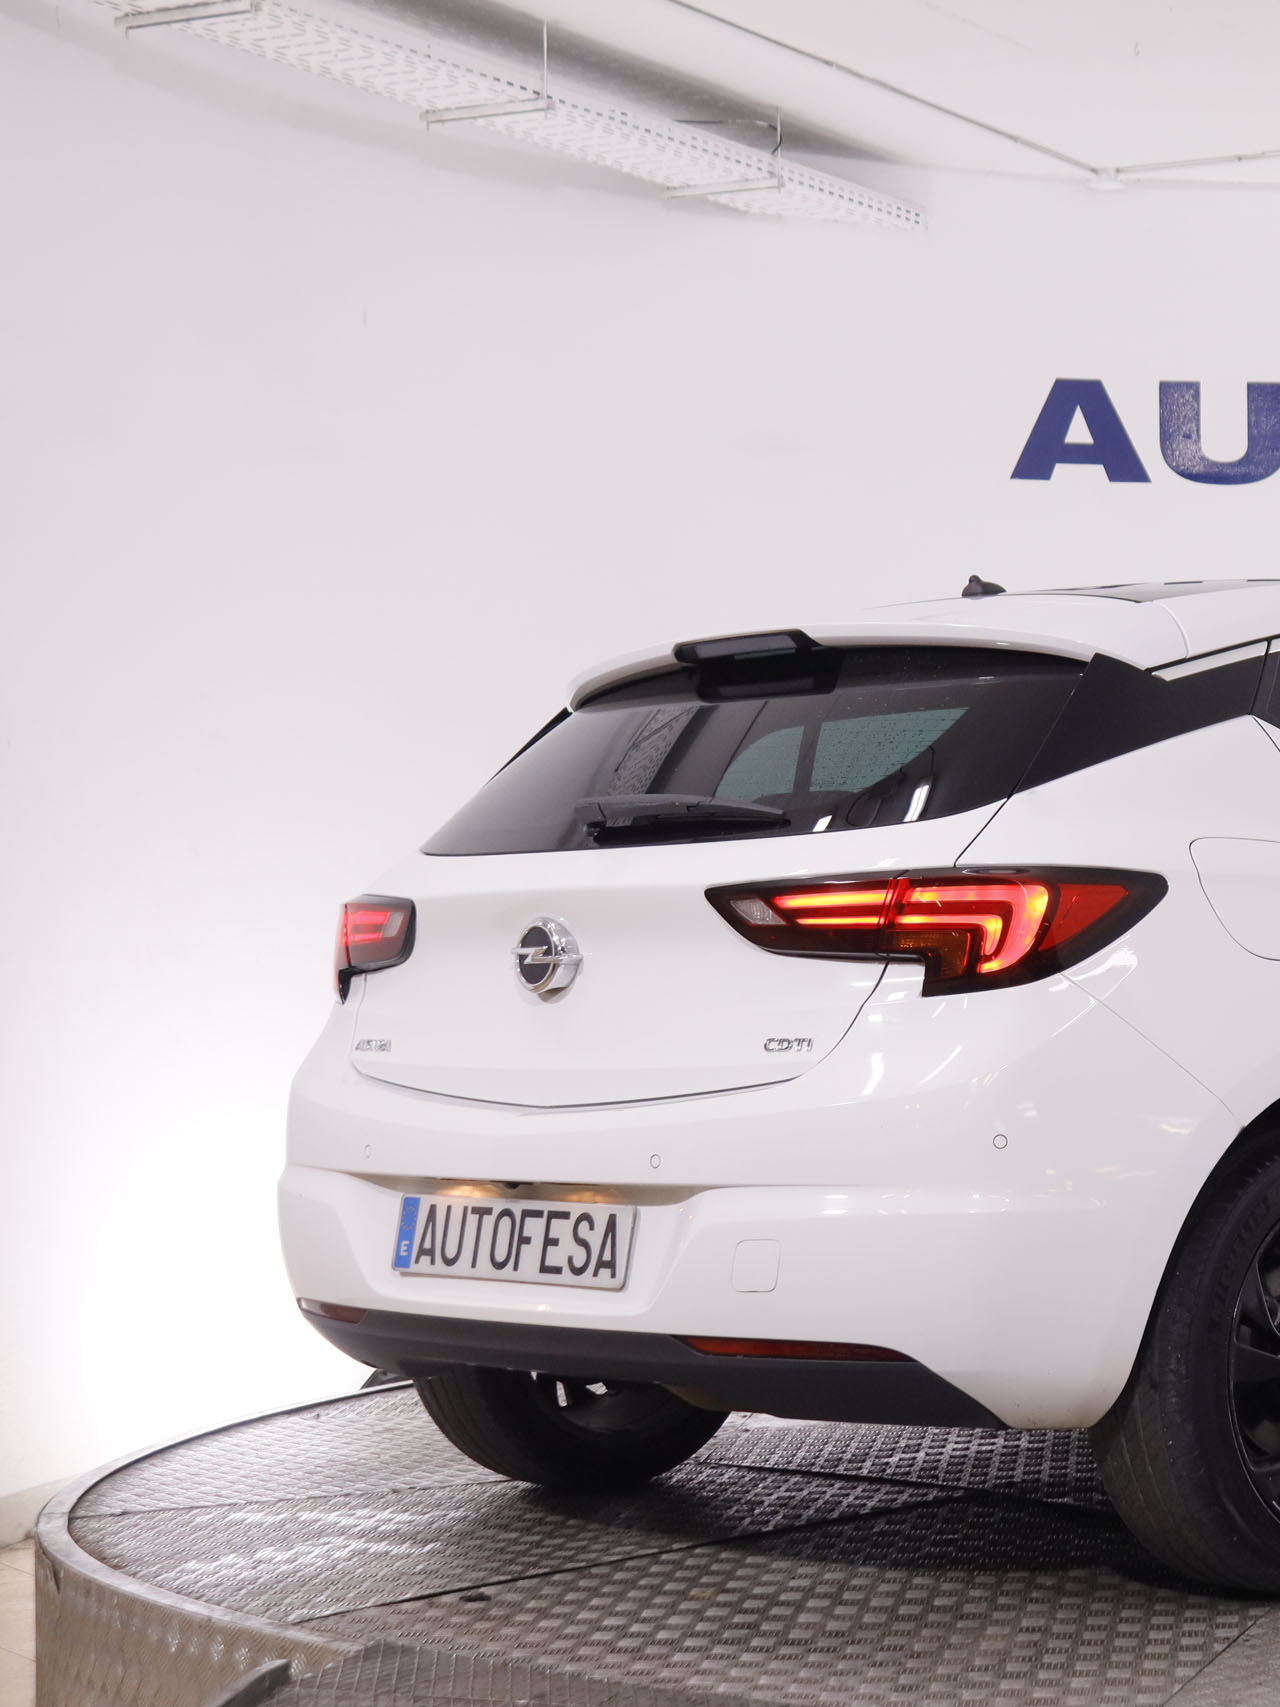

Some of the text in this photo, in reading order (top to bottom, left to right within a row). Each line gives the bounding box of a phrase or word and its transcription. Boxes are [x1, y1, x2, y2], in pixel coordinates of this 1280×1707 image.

[763, 1037, 814, 1053] CDTI
[399, 1203, 618, 1279] E AUTOFESA
